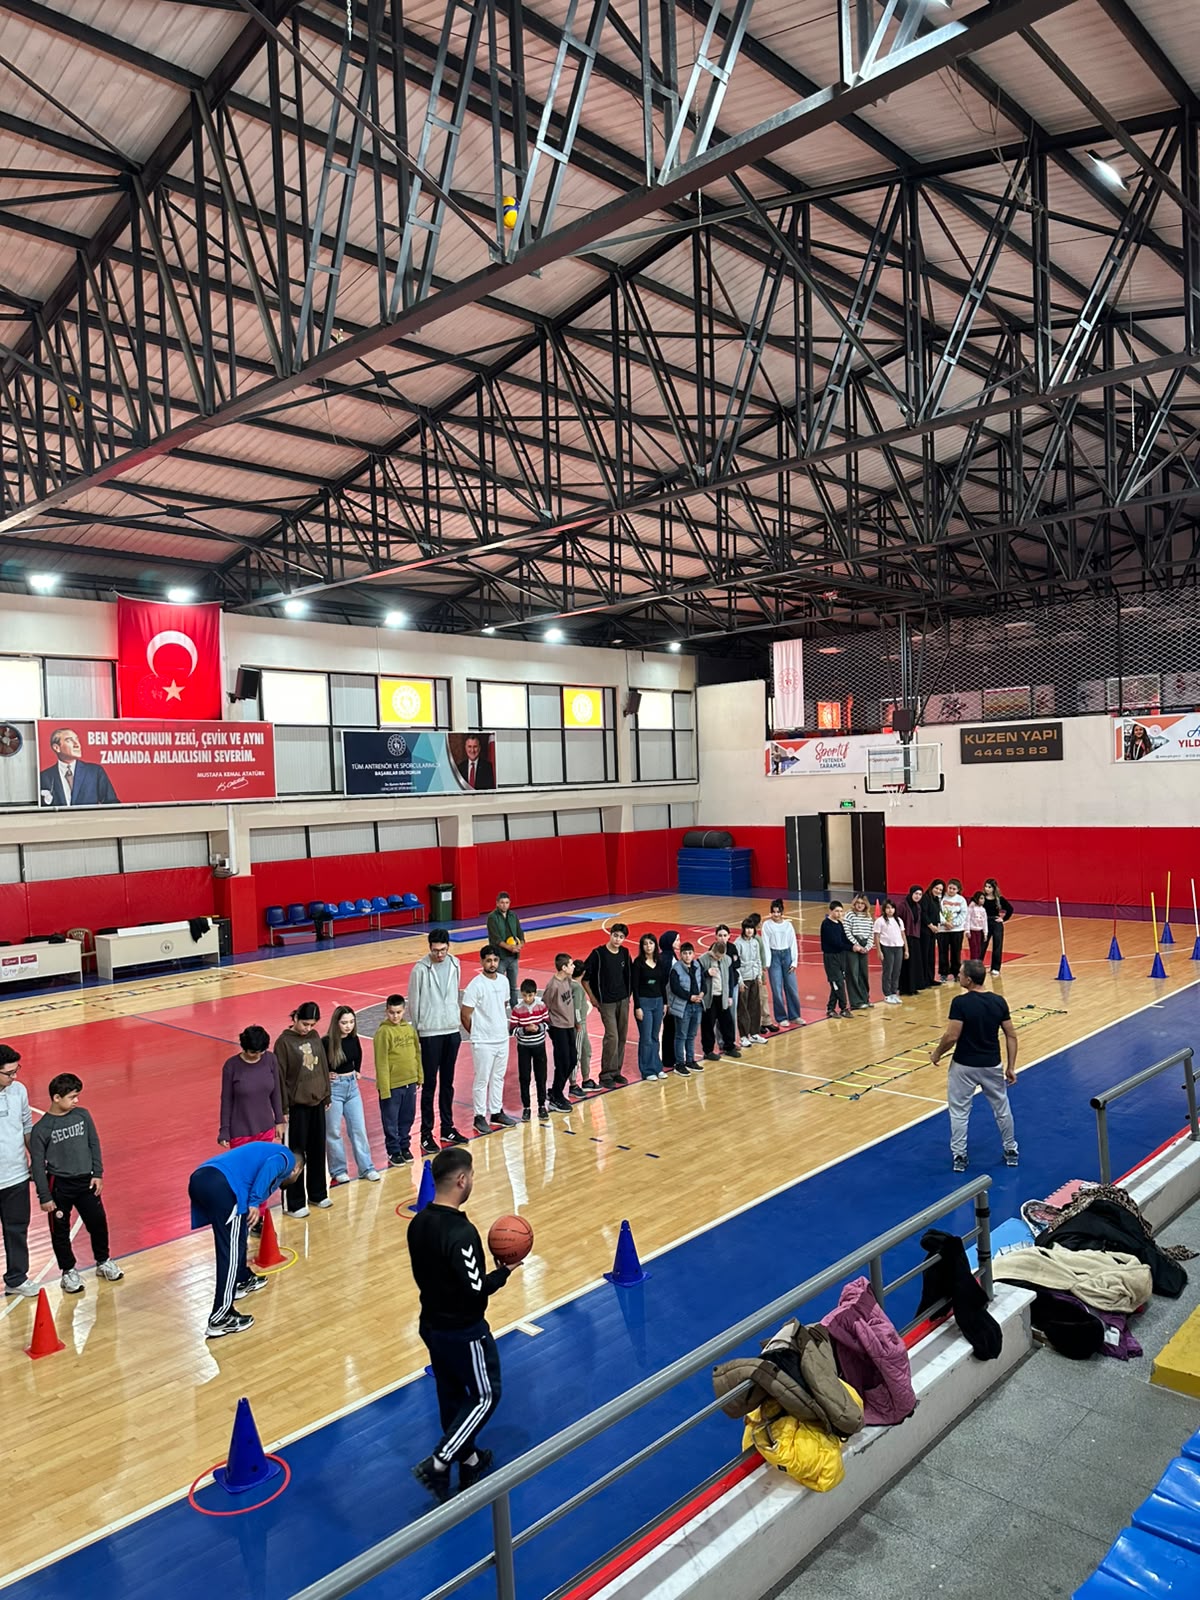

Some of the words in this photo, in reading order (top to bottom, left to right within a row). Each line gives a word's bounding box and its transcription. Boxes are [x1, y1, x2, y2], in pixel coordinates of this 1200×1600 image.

[88, 732, 108, 745] BEN
[111, 732, 172, 745] SPORCUNUN
[174, 729, 199, 748] ZEKİ,
[201, 728, 227, 749] ÇEVİK
[229, 732, 241, 745] VE
[242, 732, 264, 745] AYNI
[964, 732, 1018, 744] KUZEN
[1020, 729, 1057, 741] YAPI
[100, 750, 152, 764] ZAMANDA
[153, 749, 212, 763] AHLAKLISINI
[214, 746, 256, 763] SEVERİM.
[974, 748, 1002, 757] 444
[1006, 747, 1025, 756] 53
[1029, 746, 1048, 755] 83
[51, 1120, 85, 1144] SECURE
